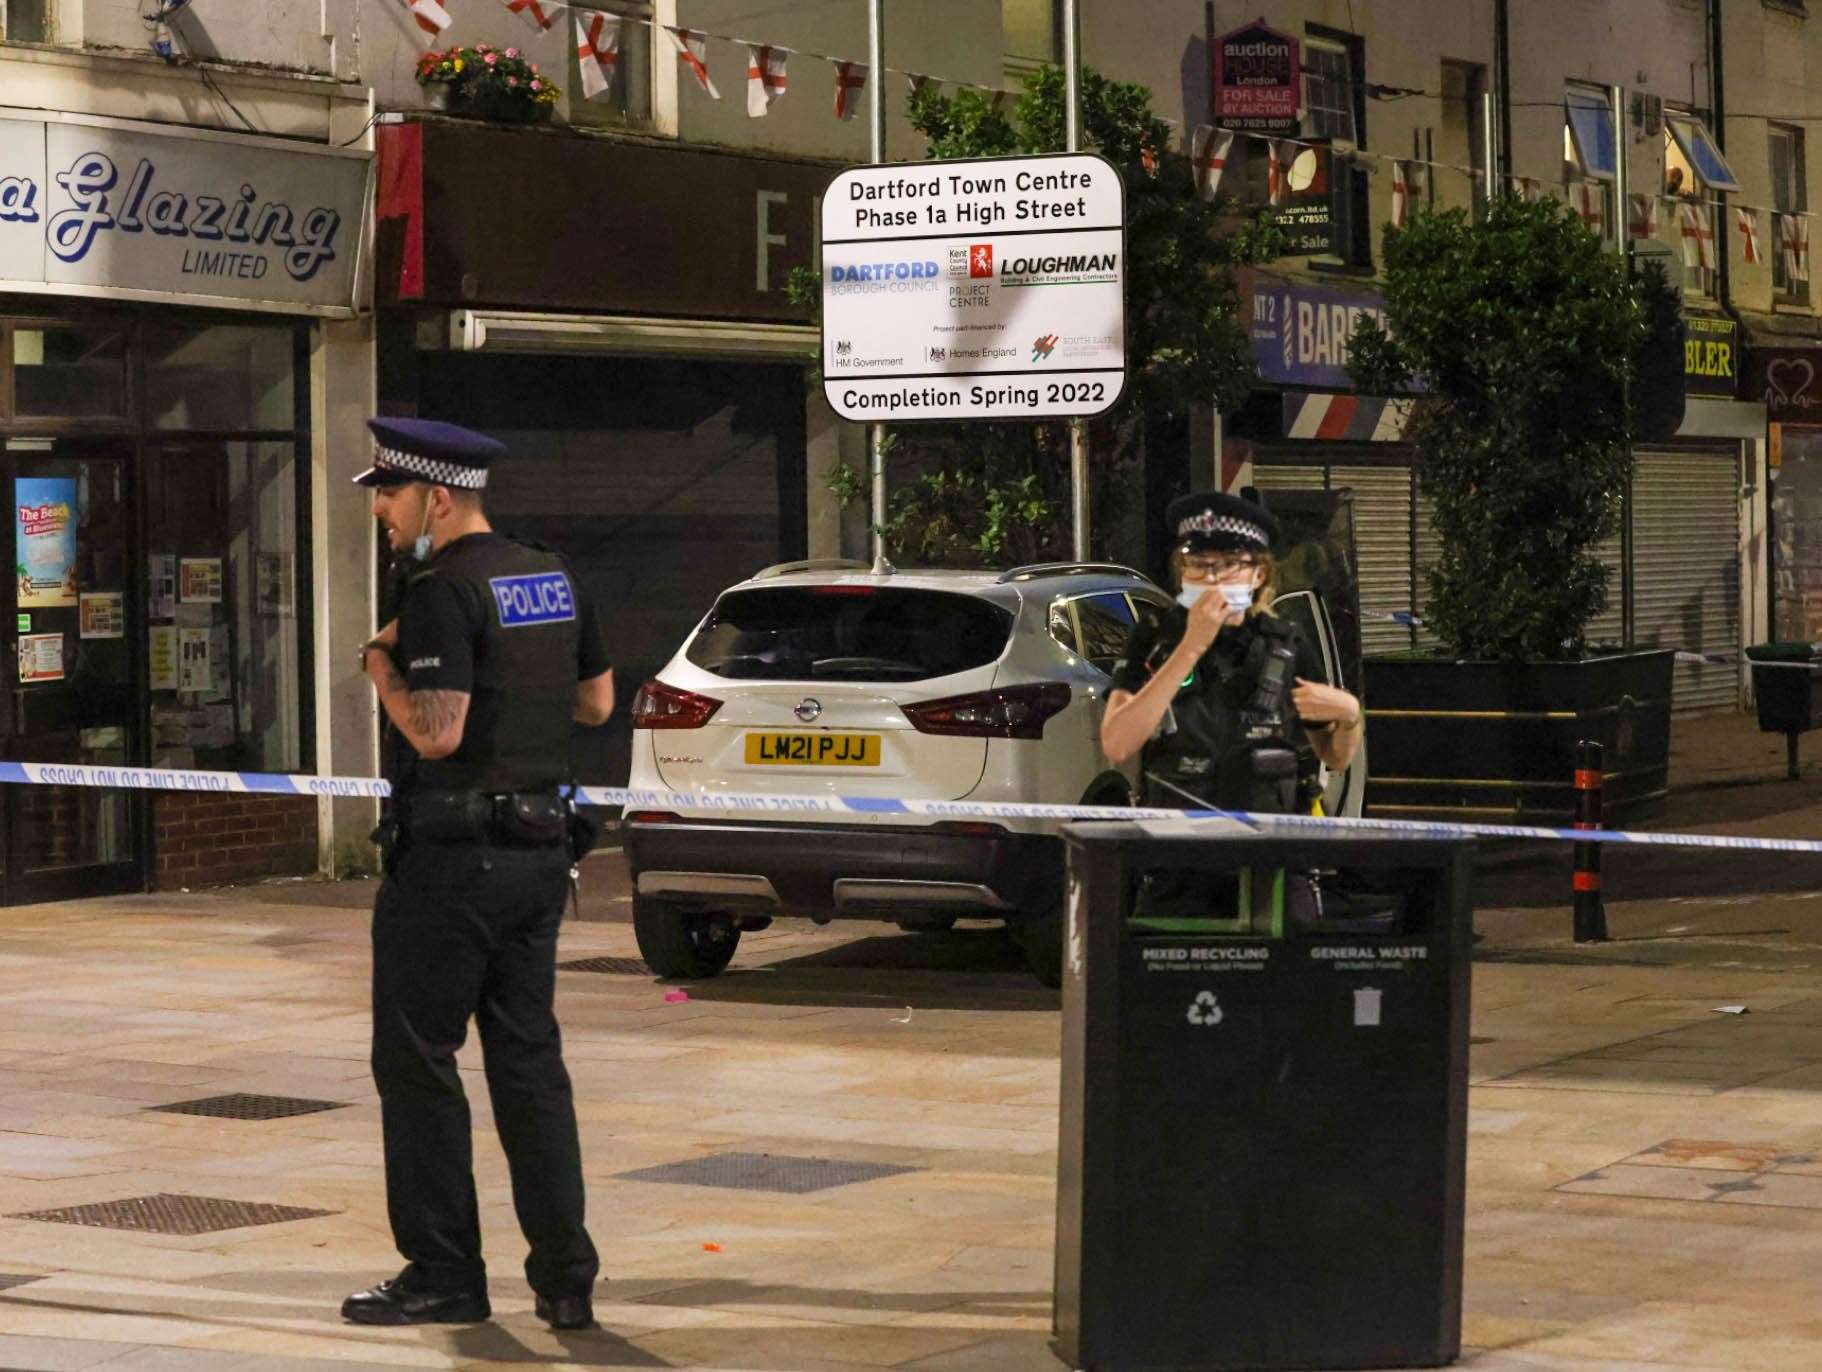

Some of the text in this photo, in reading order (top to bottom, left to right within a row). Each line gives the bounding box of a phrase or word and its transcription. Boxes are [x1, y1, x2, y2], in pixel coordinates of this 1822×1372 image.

[1223, 42, 1289, 56] auction
[1236, 76, 1278, 86] London
[1223, 89, 1292, 101] FOR SALE
[1222, 103, 1292, 113] BY AUCTION
[850, 170, 1092, 202] Dartford Town Centre
[46, 152, 341, 282] Glazing
[856, 197, 1086, 228] Phase 1a High Street
[1298, 214, 1329, 224] 478555
[1301, 235, 1329, 249] Sale
[949, 249, 968, 258] Kent
[182, 249, 267, 280] LIMITED
[1001, 254, 1116, 276] LOUGHMAN
[831, 262, 939, 282] DARTFORD
[1001, 276, 1024, 284] Building
[1046, 274, 1081, 283] Engineering
[831, 280, 940, 296] BOROUGH COUNCIL
[949, 285, 990, 297] PROJECT
[949, 297, 990, 308] CENTRE
[1268, 295, 1276, 324] 2
[933, 324, 955, 333] Project
[949, 346, 1017, 359] Homes England
[836, 356, 904, 368] HM Government
[843, 382, 1105, 410] Completion Spring 2022
[20, 507, 39, 522] The
[499, 580, 571, 617] POLICE
[410, 656, 441, 670] POLICE
[760, 736, 866, 761] LM21 PJJ
[1142, 948, 1270, 960] MIXED RECYCLING
[1310, 947, 1428, 958] GENERAL WASTE
